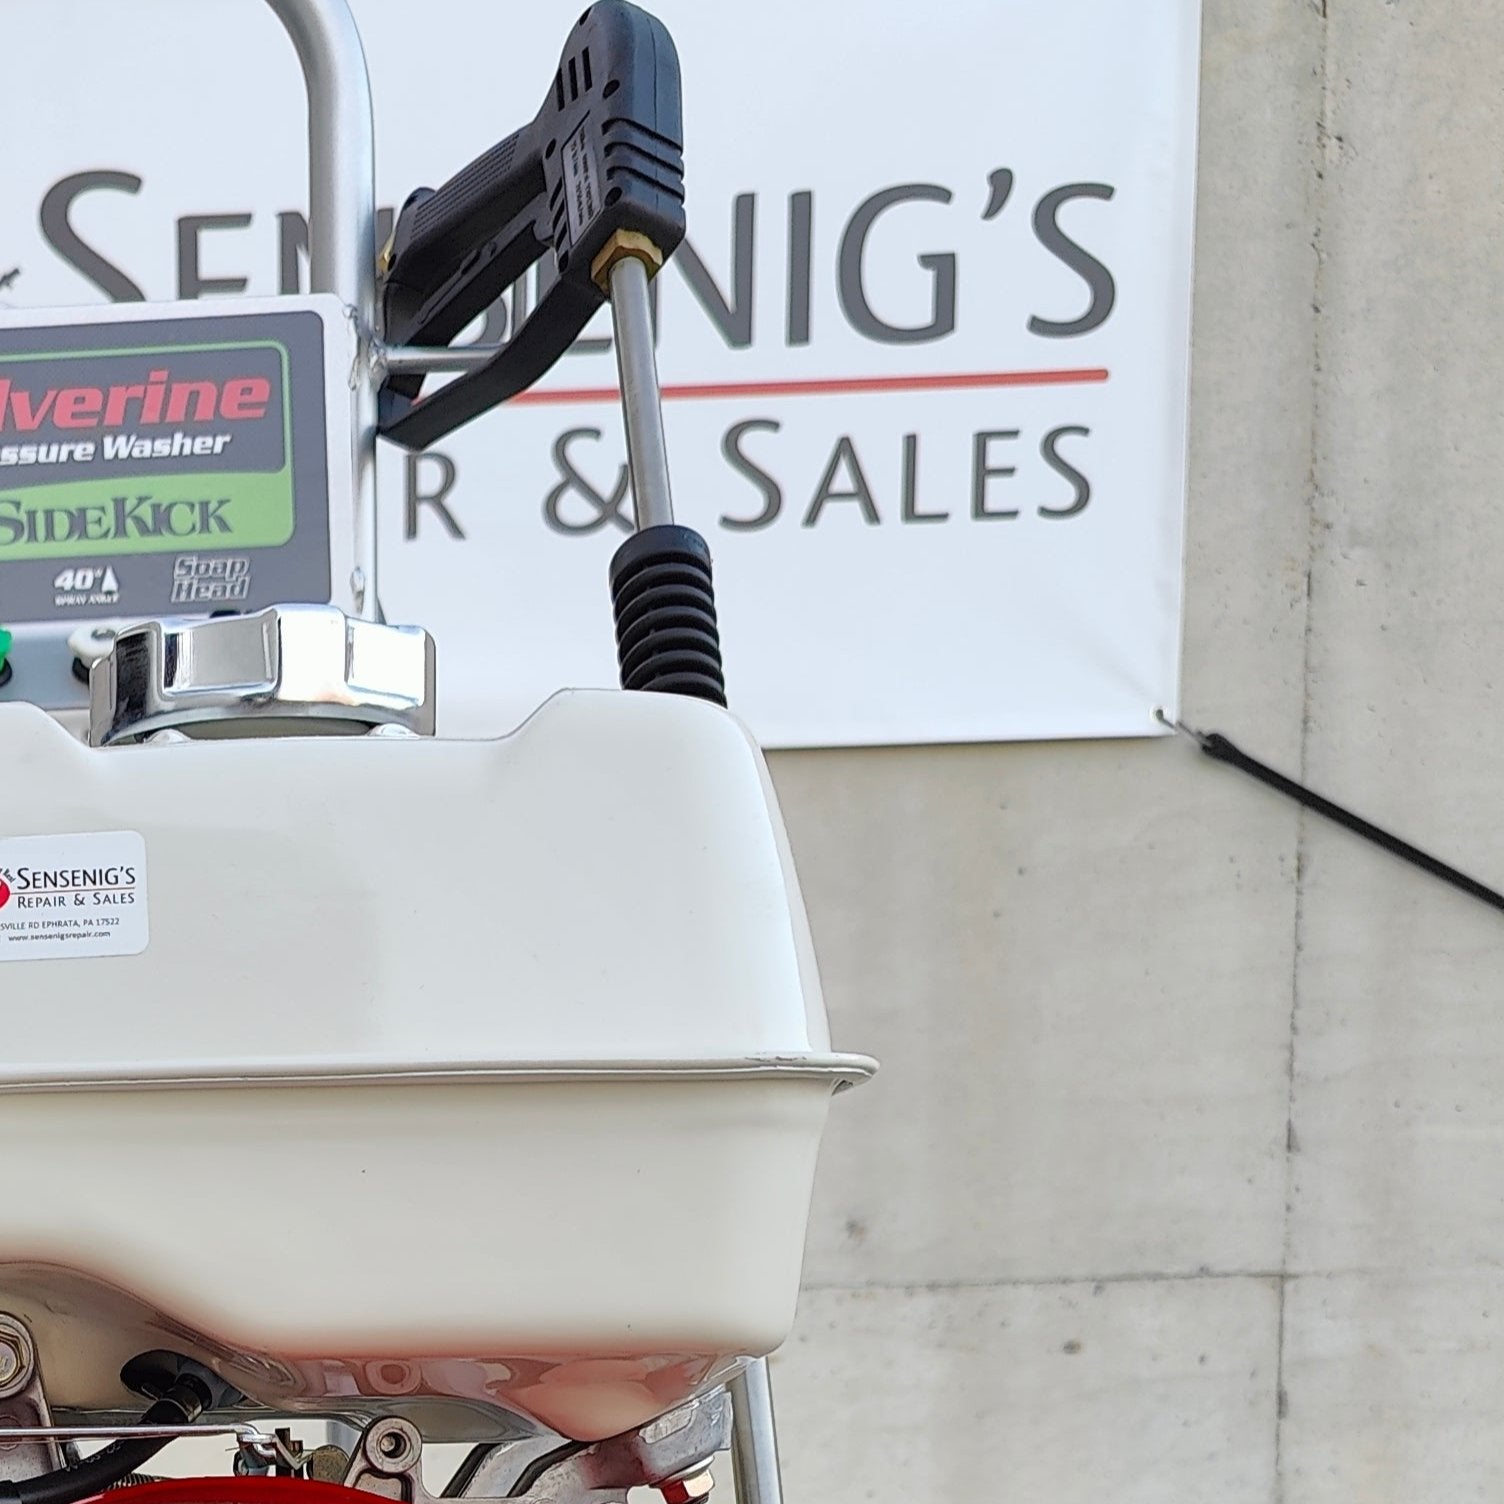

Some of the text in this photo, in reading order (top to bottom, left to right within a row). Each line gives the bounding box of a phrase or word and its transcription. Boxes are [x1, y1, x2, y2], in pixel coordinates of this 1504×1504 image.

[39, 167, 1117, 354] SENIG'S
[102, 431, 231, 460] Washer
[542, 426, 634, 536] &
[719, 418, 1093, 533] SALES
[173, 555, 251, 581] Soap
[16, 865, 136, 890] SENSENIG'S
[16, 891, 135, 909] REPAIR & SALES
[28, 922, 39, 930] RD
[41, 919, 81, 930] EPHRATA,
[95, 917, 120, 926] 17522
